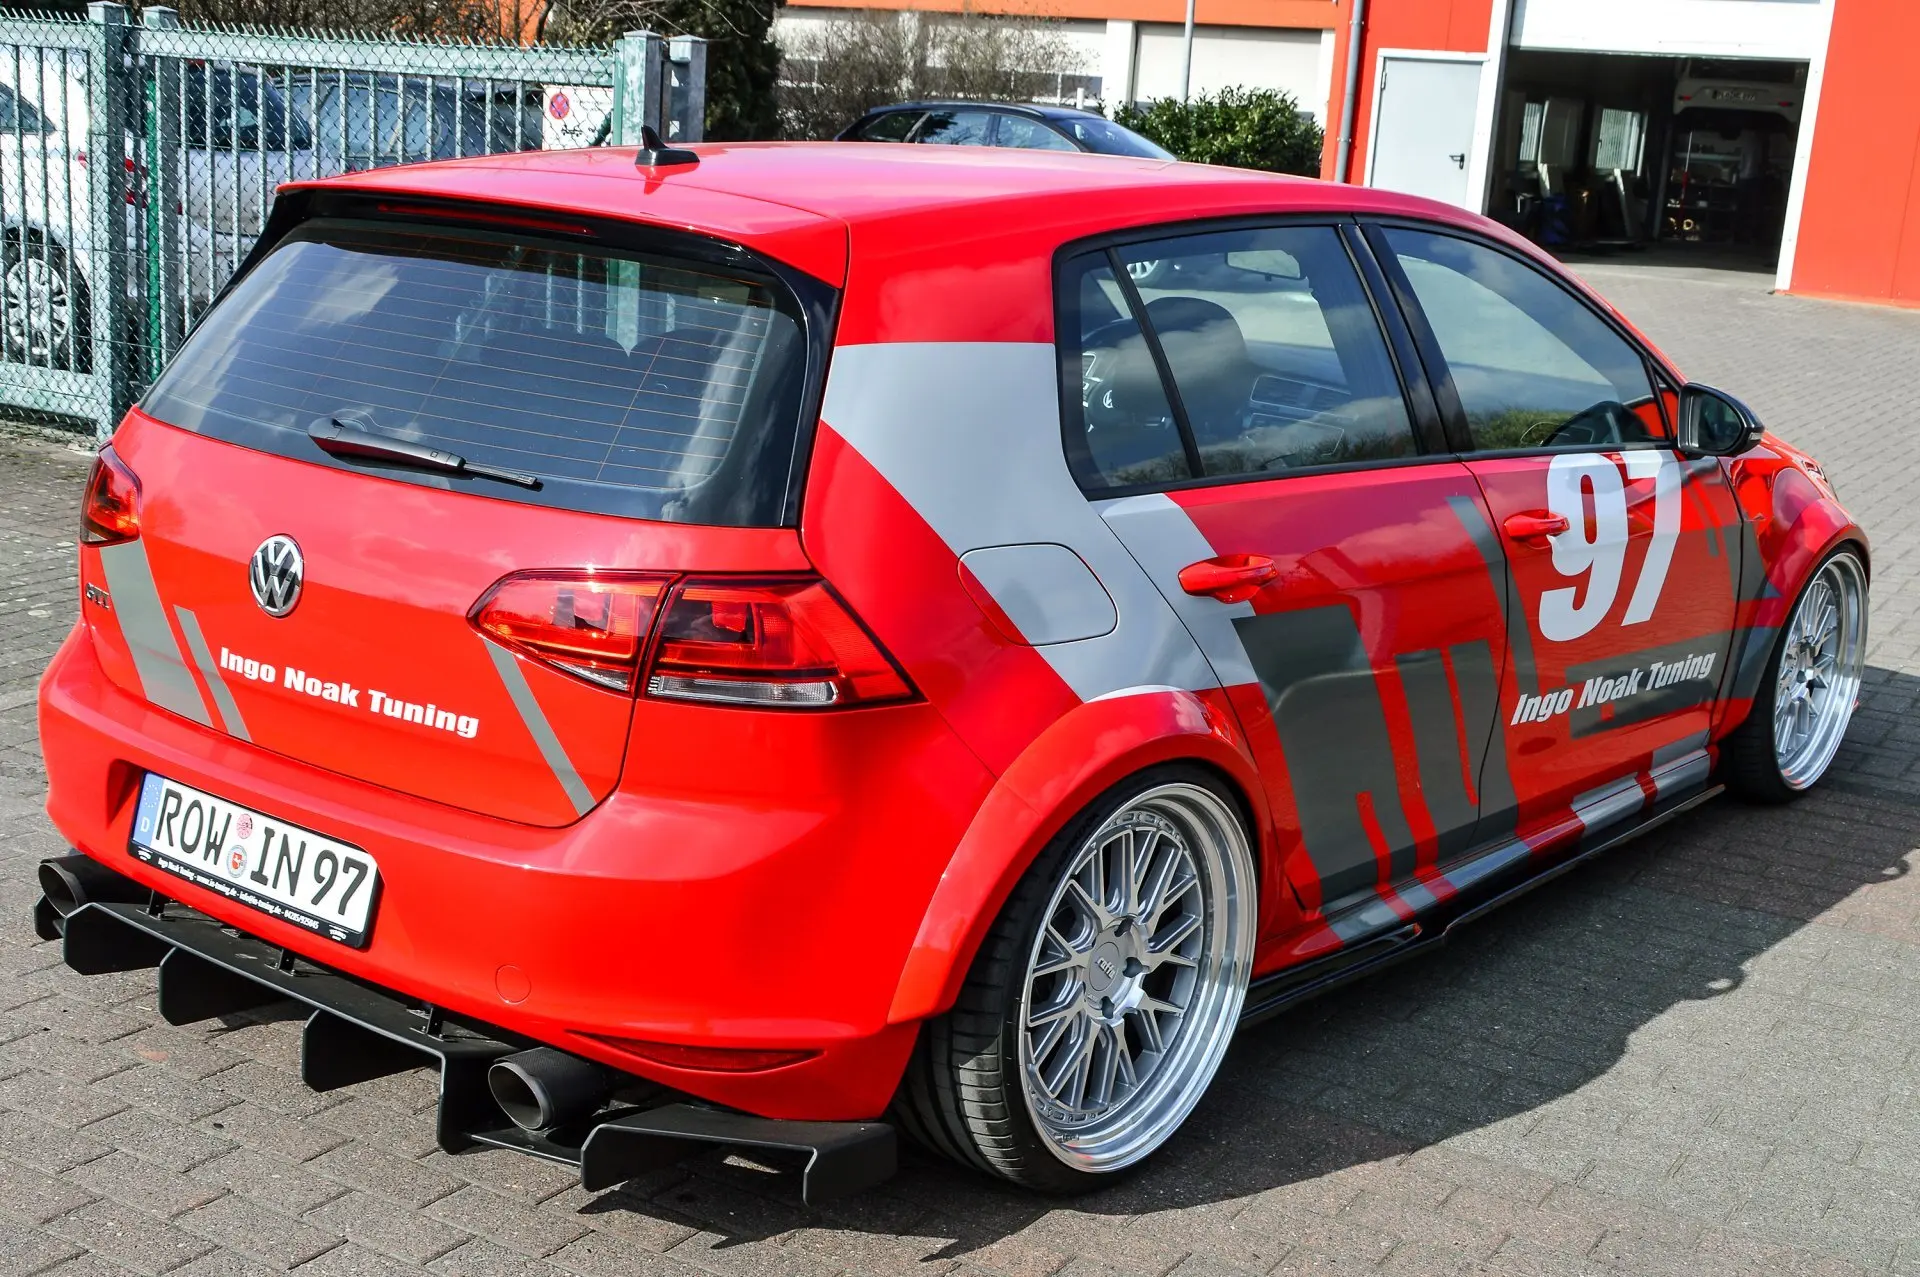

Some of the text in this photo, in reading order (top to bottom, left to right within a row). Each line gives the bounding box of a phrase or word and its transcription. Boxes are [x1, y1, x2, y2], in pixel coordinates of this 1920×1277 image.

[1539, 450, 1682, 642] 97
[220, 646, 480, 739] Ingo Noak Tuning
[1511, 652, 1717, 726] Ingo Noak Tuning
[140, 817, 150, 832] D
[155, 787, 232, 866] ROW
[250, 826, 307, 897] IN
[311, 849, 369, 916] 97
